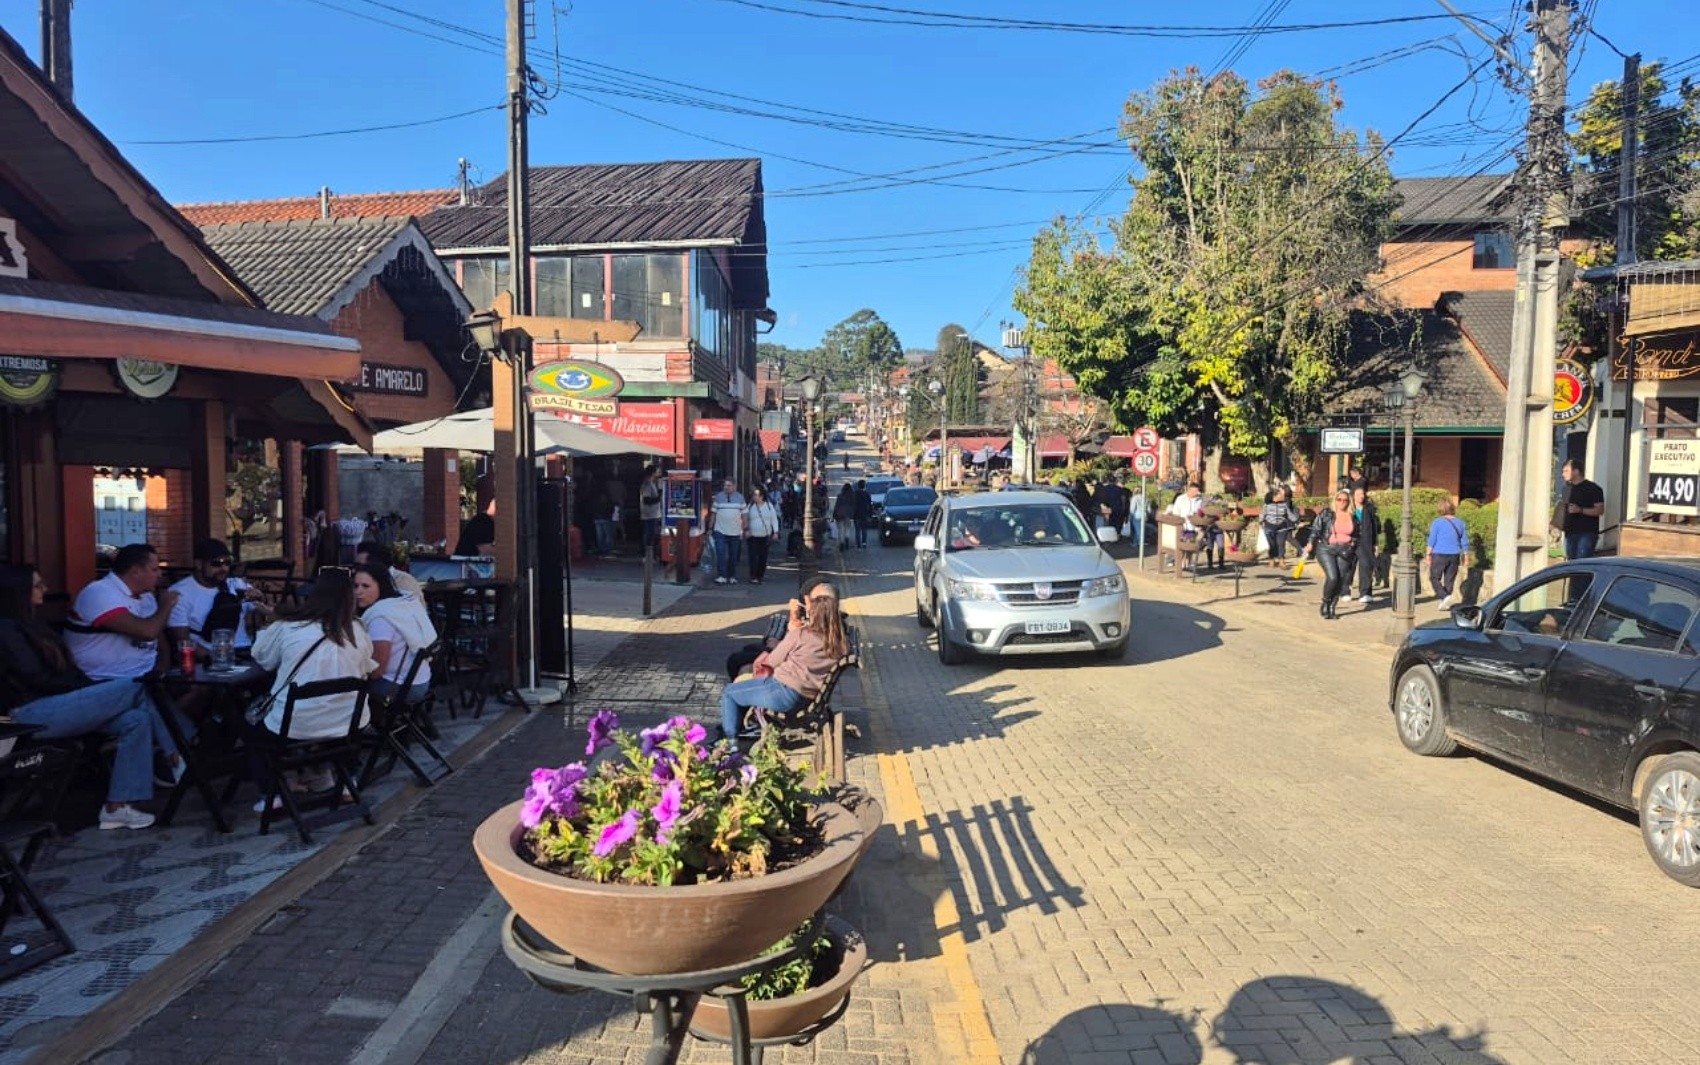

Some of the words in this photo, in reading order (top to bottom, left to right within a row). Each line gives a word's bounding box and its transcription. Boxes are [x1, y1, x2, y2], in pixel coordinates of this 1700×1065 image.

[375, 368, 423, 391] AMARELO
[1663, 443, 1688, 451] PRATO
[1137, 455, 1154, 467] 30
[1654, 452, 1696, 461] EXECUTIVO
